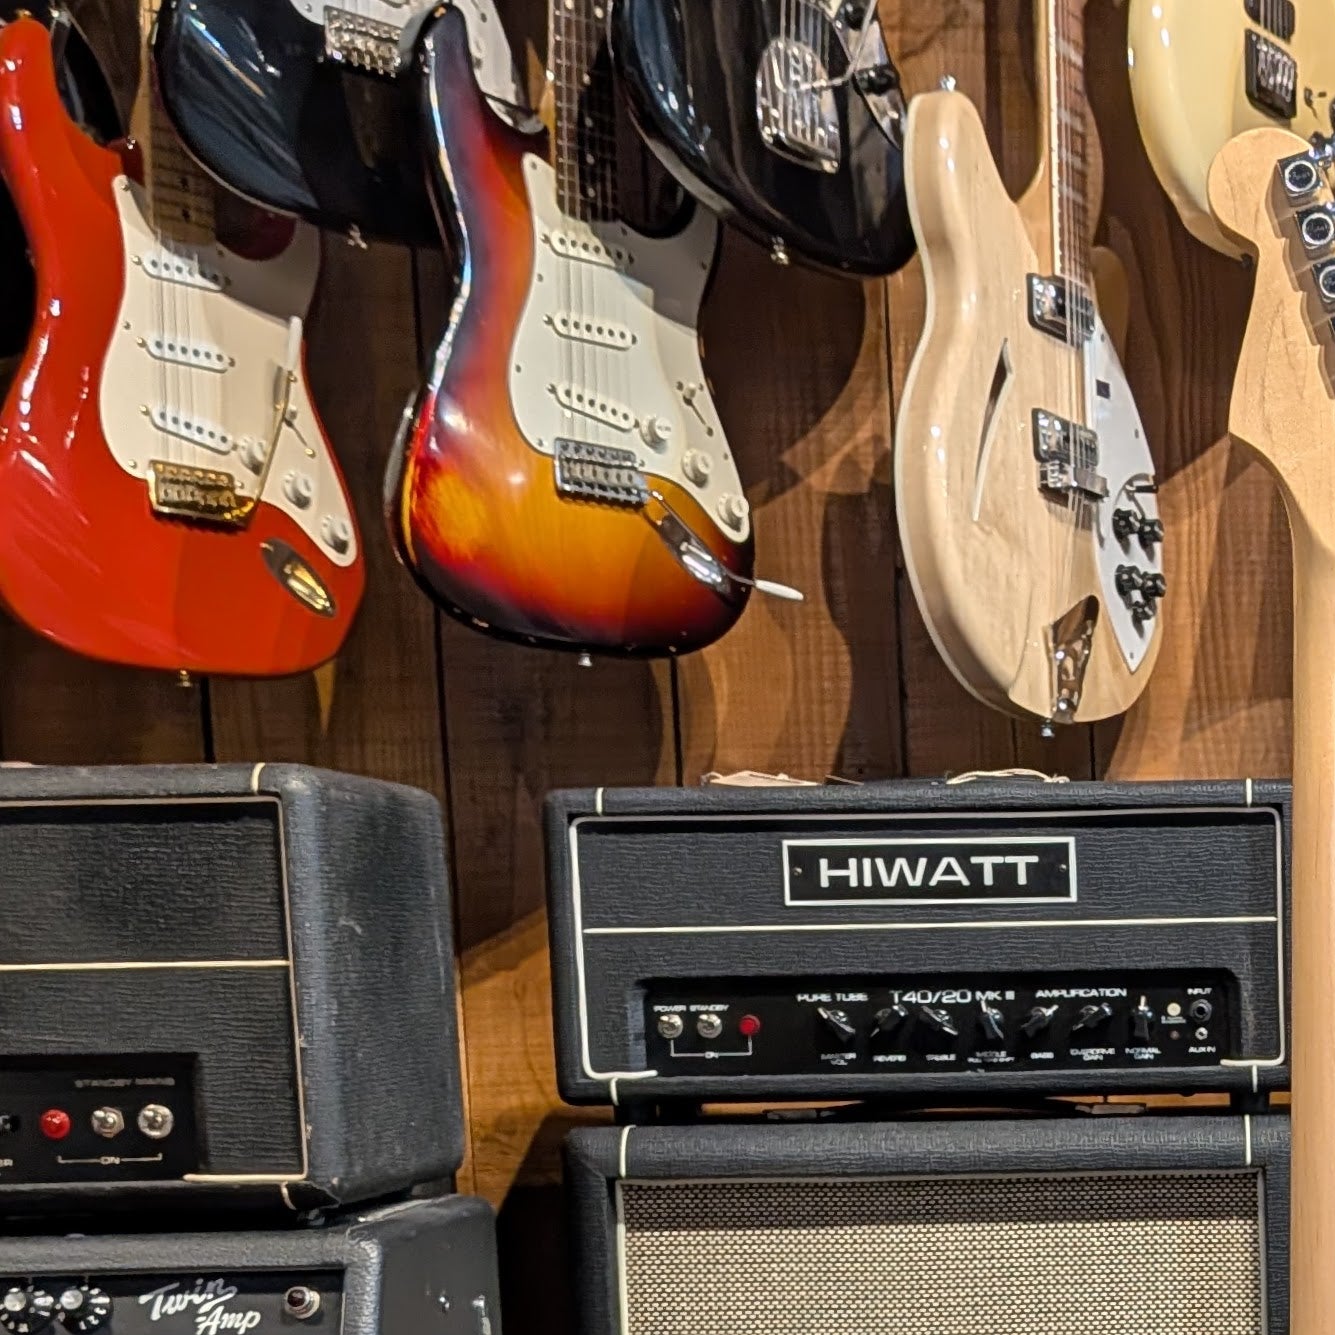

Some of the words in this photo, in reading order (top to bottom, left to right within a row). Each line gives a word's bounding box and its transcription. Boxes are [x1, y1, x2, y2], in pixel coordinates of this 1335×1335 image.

[818, 855, 1039, 888] HIWATT
[796, 993, 832, 1002] PURE
[835, 992, 868, 1002] TUBE
[889, 989, 972, 1004] T40/20
[975, 990, 1002, 1001] MK
[1035, 988, 1128, 998] AMPLIFICATION
[653, 1004, 687, 1012] POWER
[689, 1004, 729, 1012] STANDBY
[101, 1156, 120, 1164] ON
[138, 1278, 238, 1321] Twin
